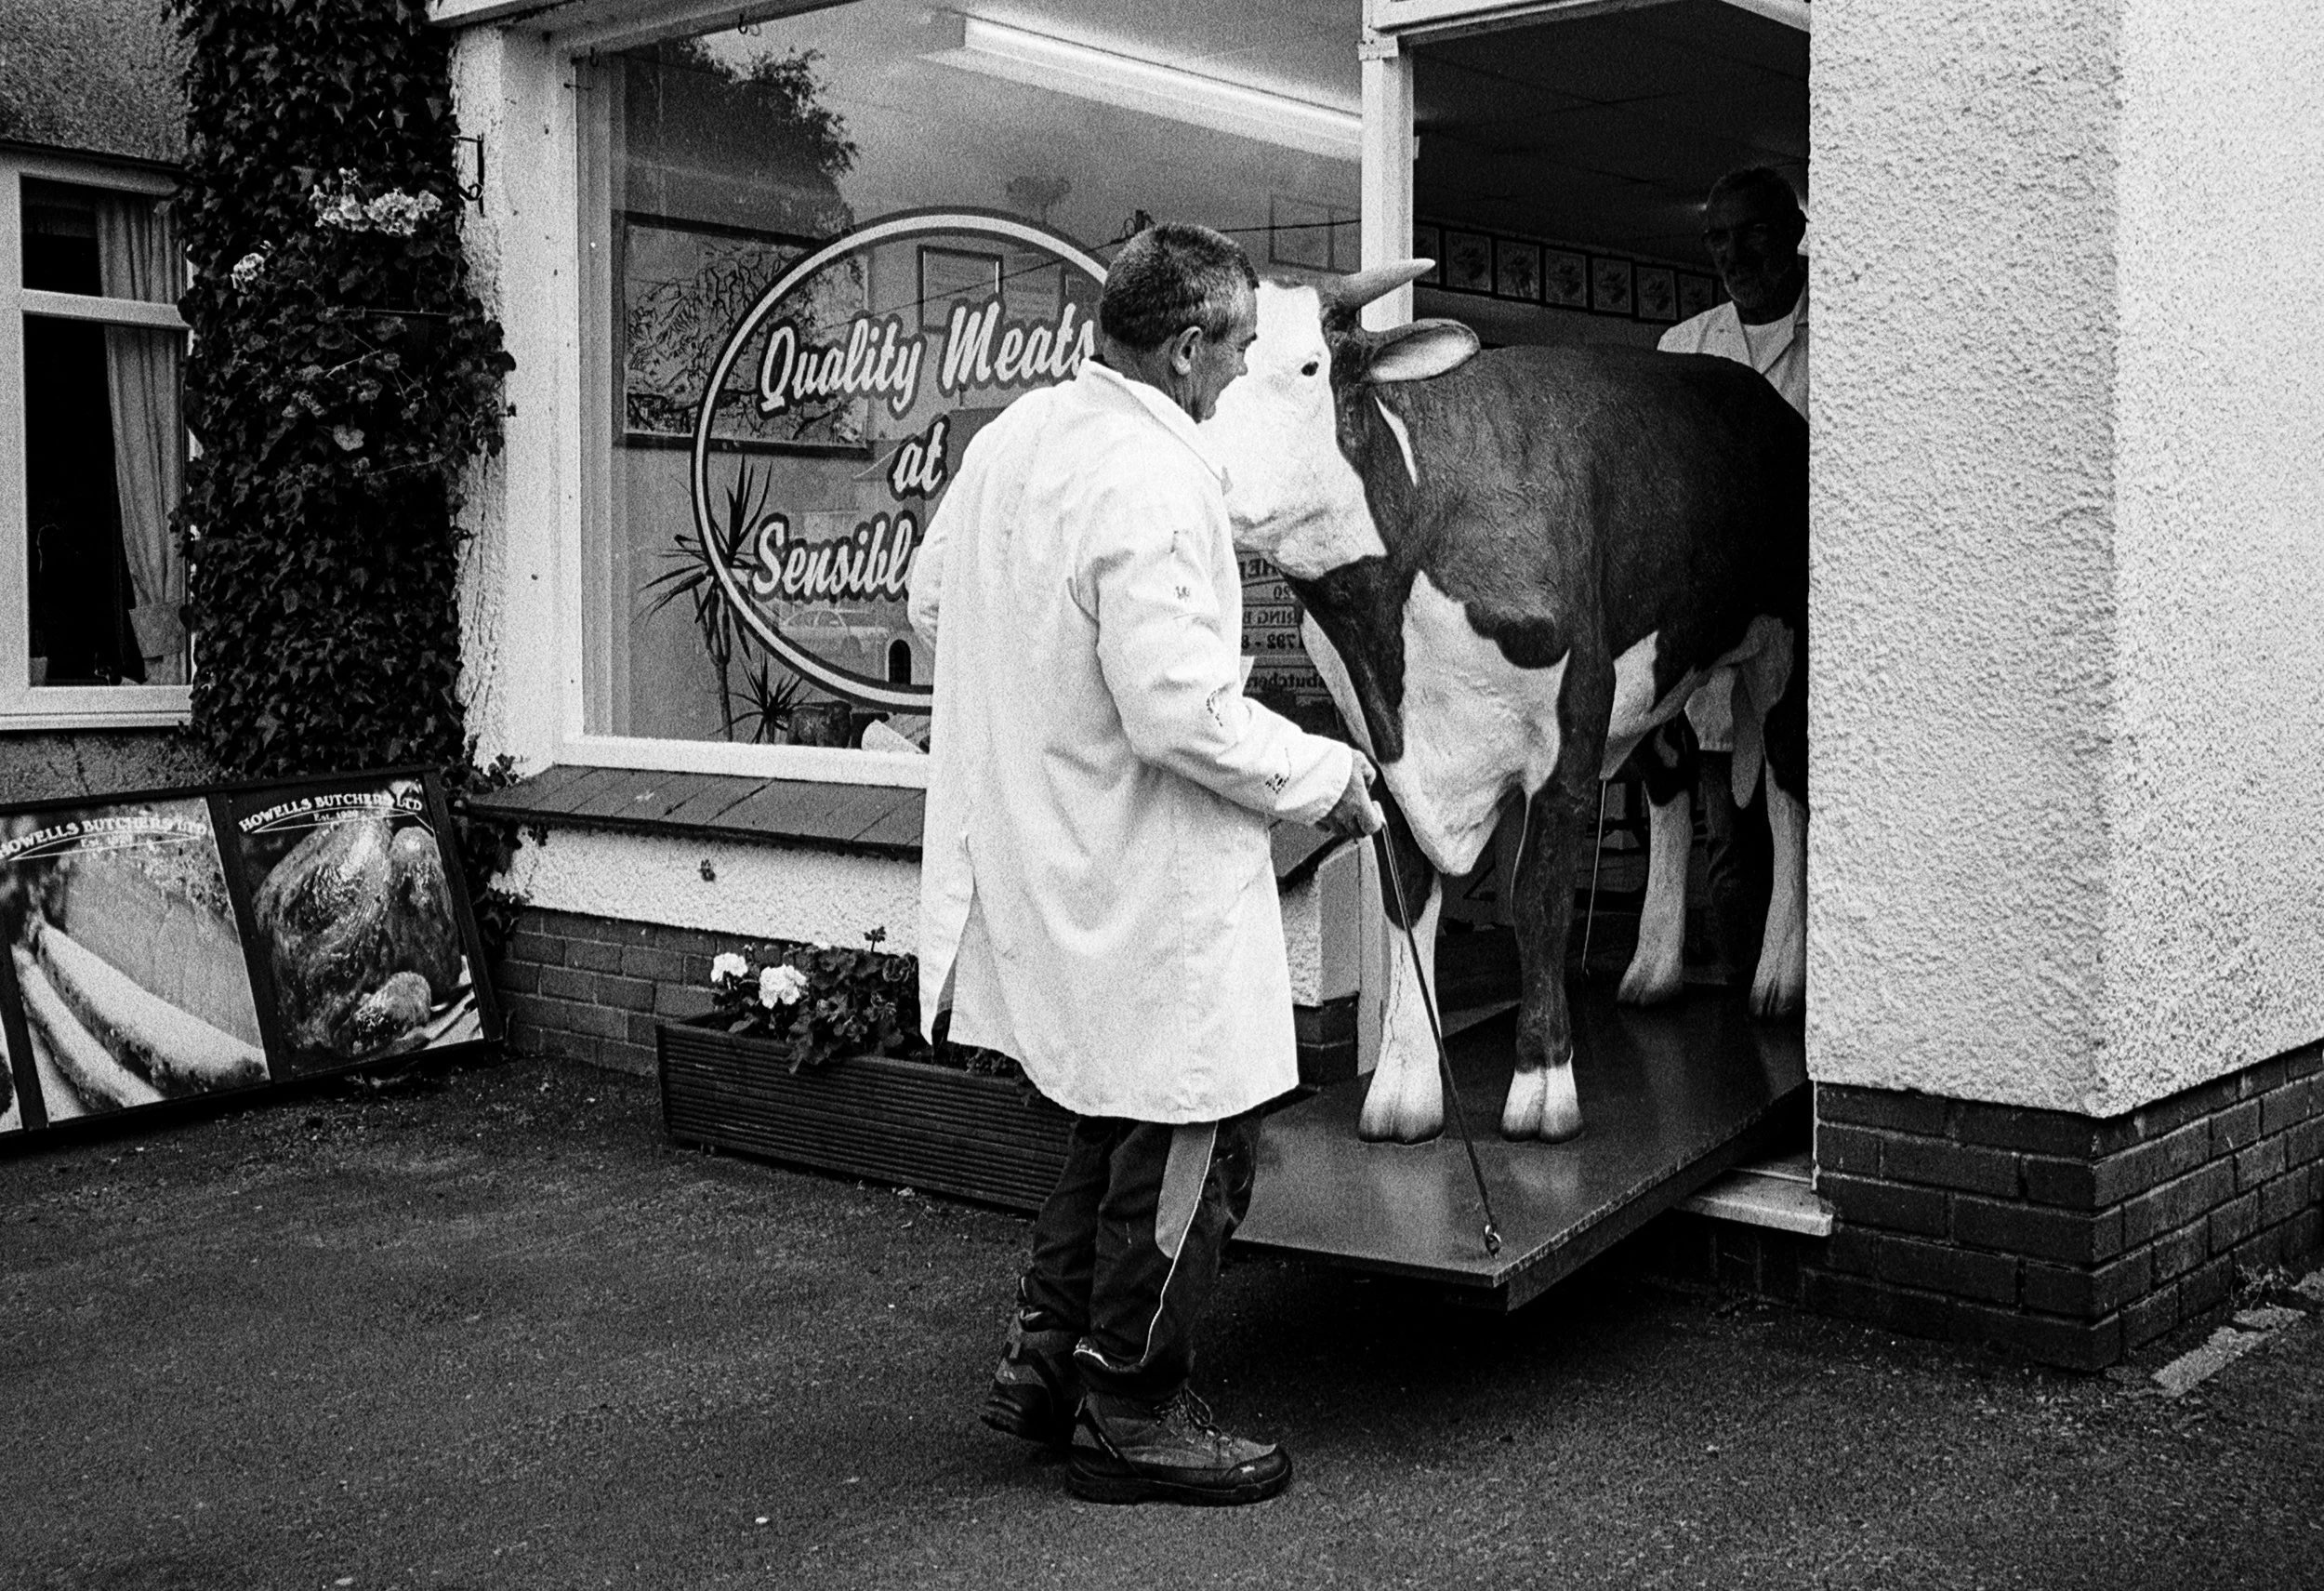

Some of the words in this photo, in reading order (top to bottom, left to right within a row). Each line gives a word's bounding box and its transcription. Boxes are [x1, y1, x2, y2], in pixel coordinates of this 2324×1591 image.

[758, 314, 924, 416] Quality
[940, 298, 1096, 392] Meats
[891, 418, 947, 497] at
[751, 514, 914, 600] Sensibl
[81, 816, 173, 833] BUTCHERS
[176, 819, 208, 836] LTD
[238, 797, 312, 832] HOWELLS
[314, 792, 395, 808] BUTCHERS
[396, 797, 423, 812] LTD
